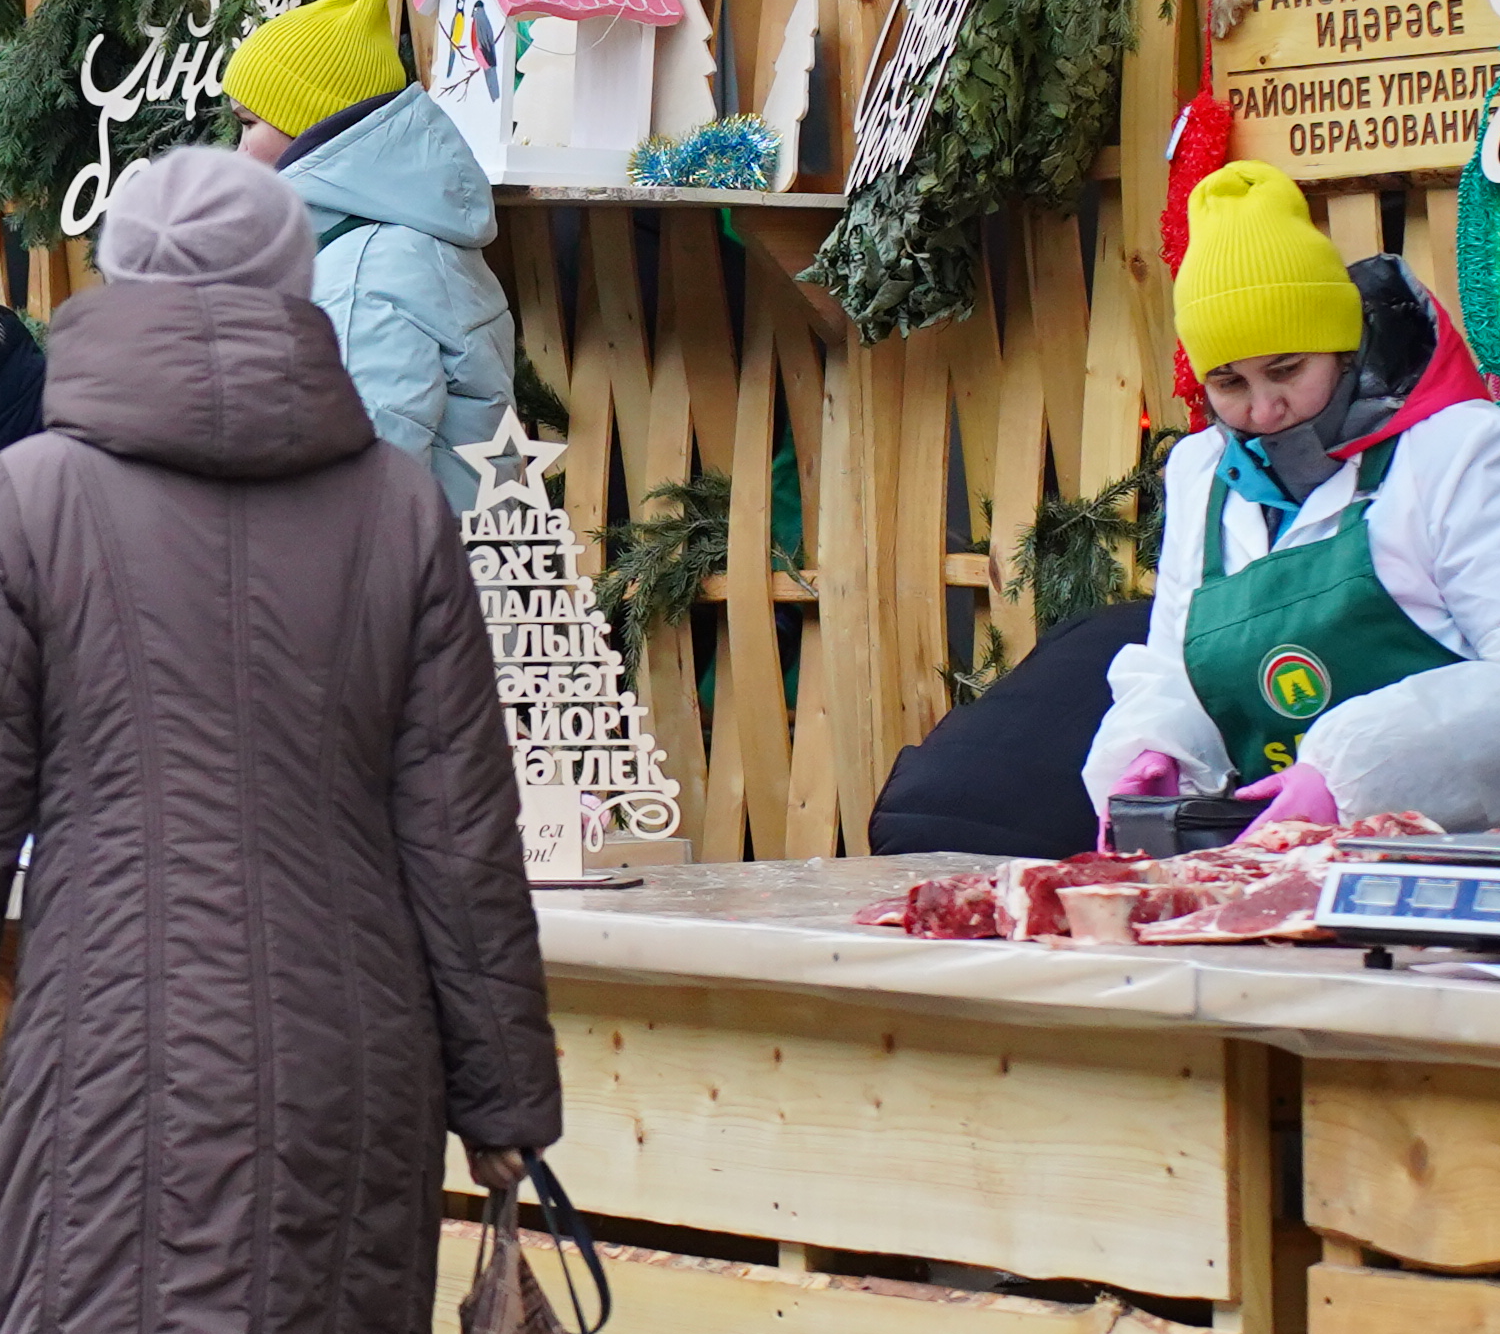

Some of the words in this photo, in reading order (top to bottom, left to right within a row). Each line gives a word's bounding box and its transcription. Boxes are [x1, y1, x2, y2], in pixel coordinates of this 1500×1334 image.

[1228, 75, 1372, 120] РАЙОННОЕ
[468, 544, 587, 582] ӘХЕТ
[480, 589, 598, 623] ЛАЛАР
[487, 622, 613, 660] ТЛЫК
[497, 663, 626, 699] ӘББӘТ
[513, 748, 668, 788] ӘТЛЕК
[522, 845, 556, 864] ән!
